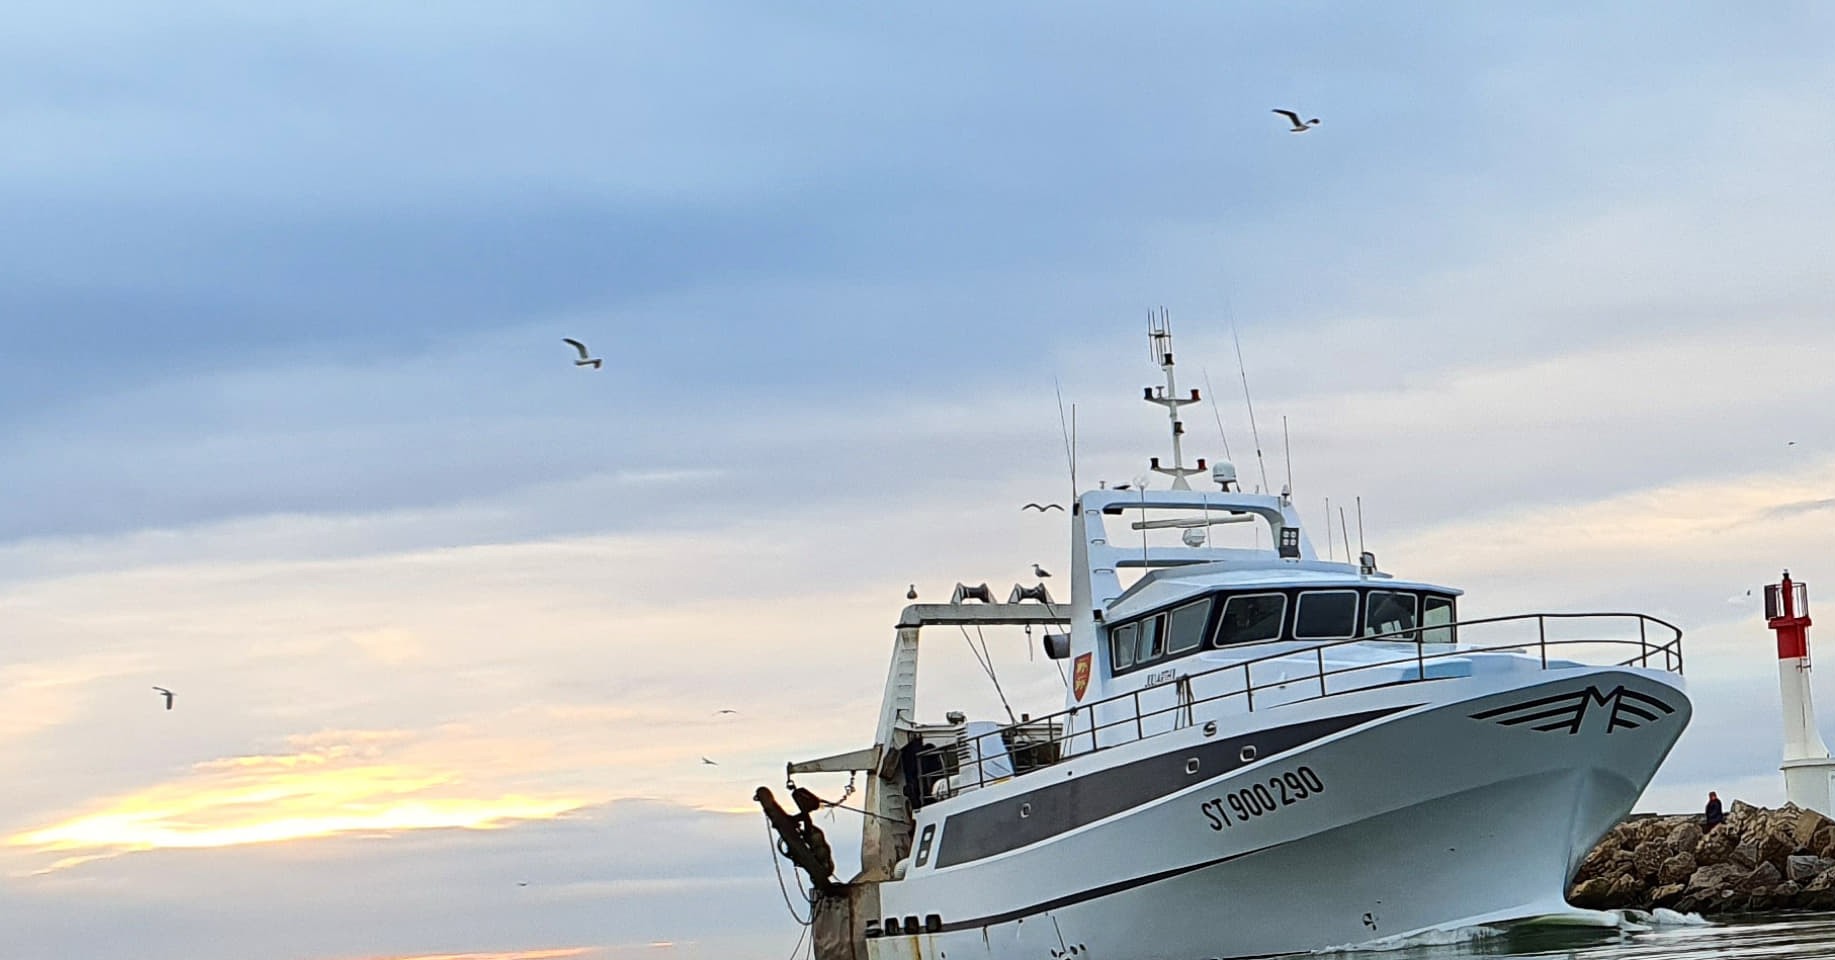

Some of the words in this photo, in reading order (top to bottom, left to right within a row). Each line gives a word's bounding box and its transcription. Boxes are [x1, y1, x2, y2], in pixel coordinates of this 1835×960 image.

[1201, 798, 1232, 831] ST
[1227, 783, 1277, 821] 900
[1269, 766, 1324, 806] 290
